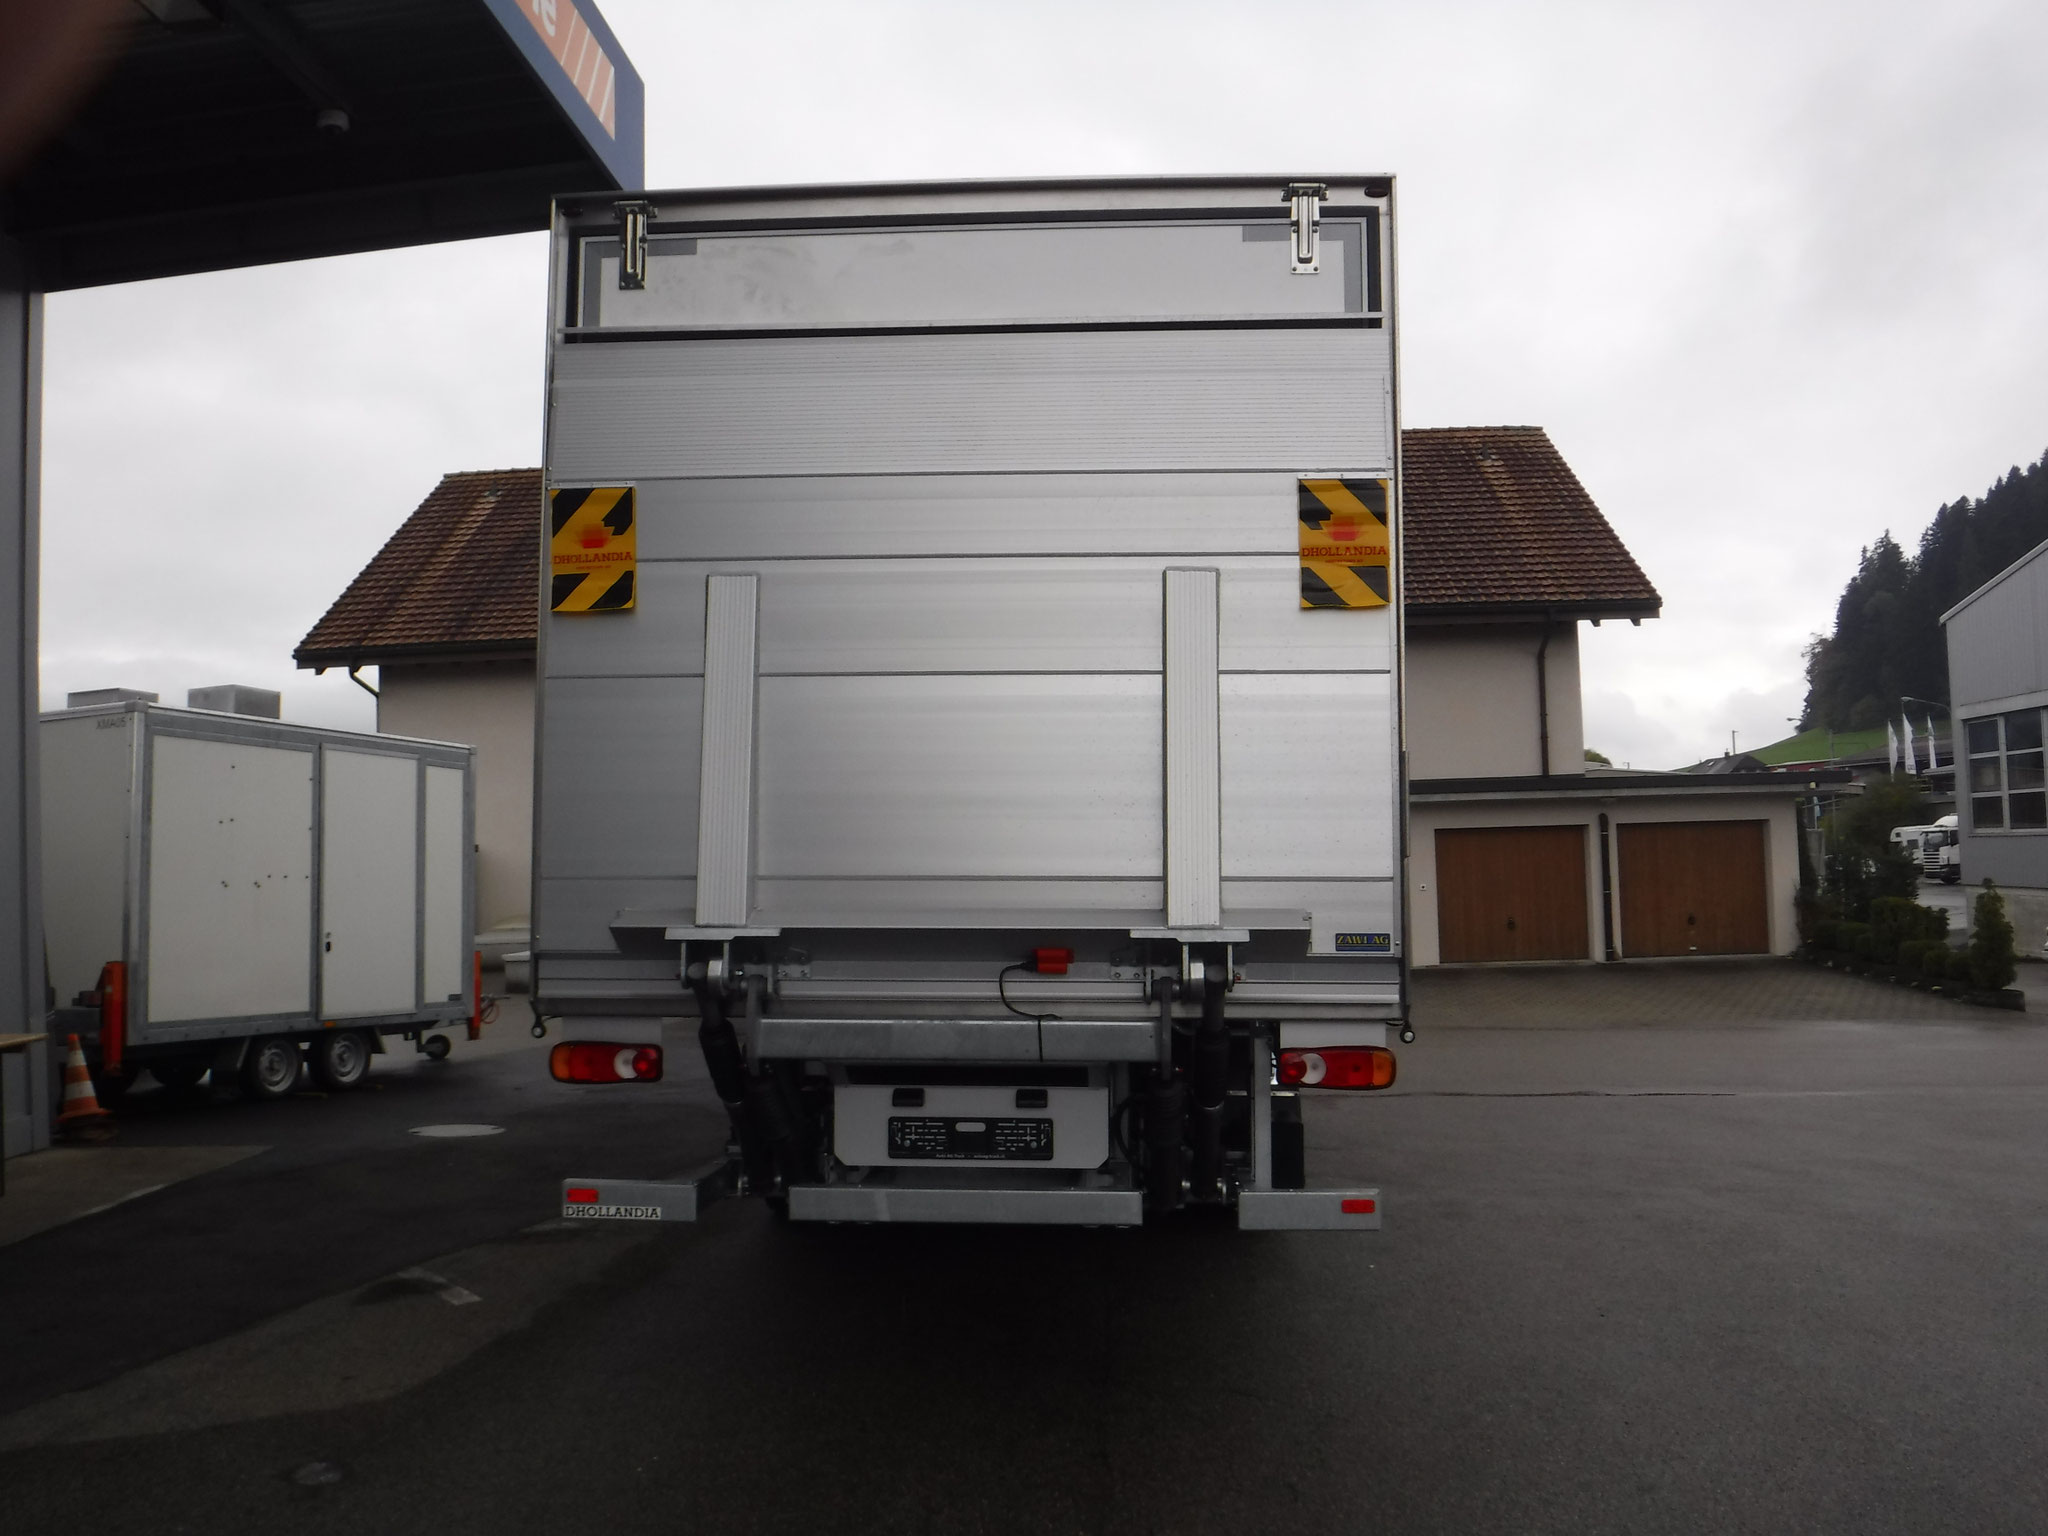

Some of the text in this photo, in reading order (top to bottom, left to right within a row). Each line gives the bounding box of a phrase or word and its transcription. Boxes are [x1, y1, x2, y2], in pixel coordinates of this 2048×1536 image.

[1302, 545, 1387, 557] DHOLLANDIA
[553, 551, 632, 564] DHOLLANDIA
[1372, 935, 1389, 944] AG
[565, 1205, 659, 1218] DHOLLANDIA
